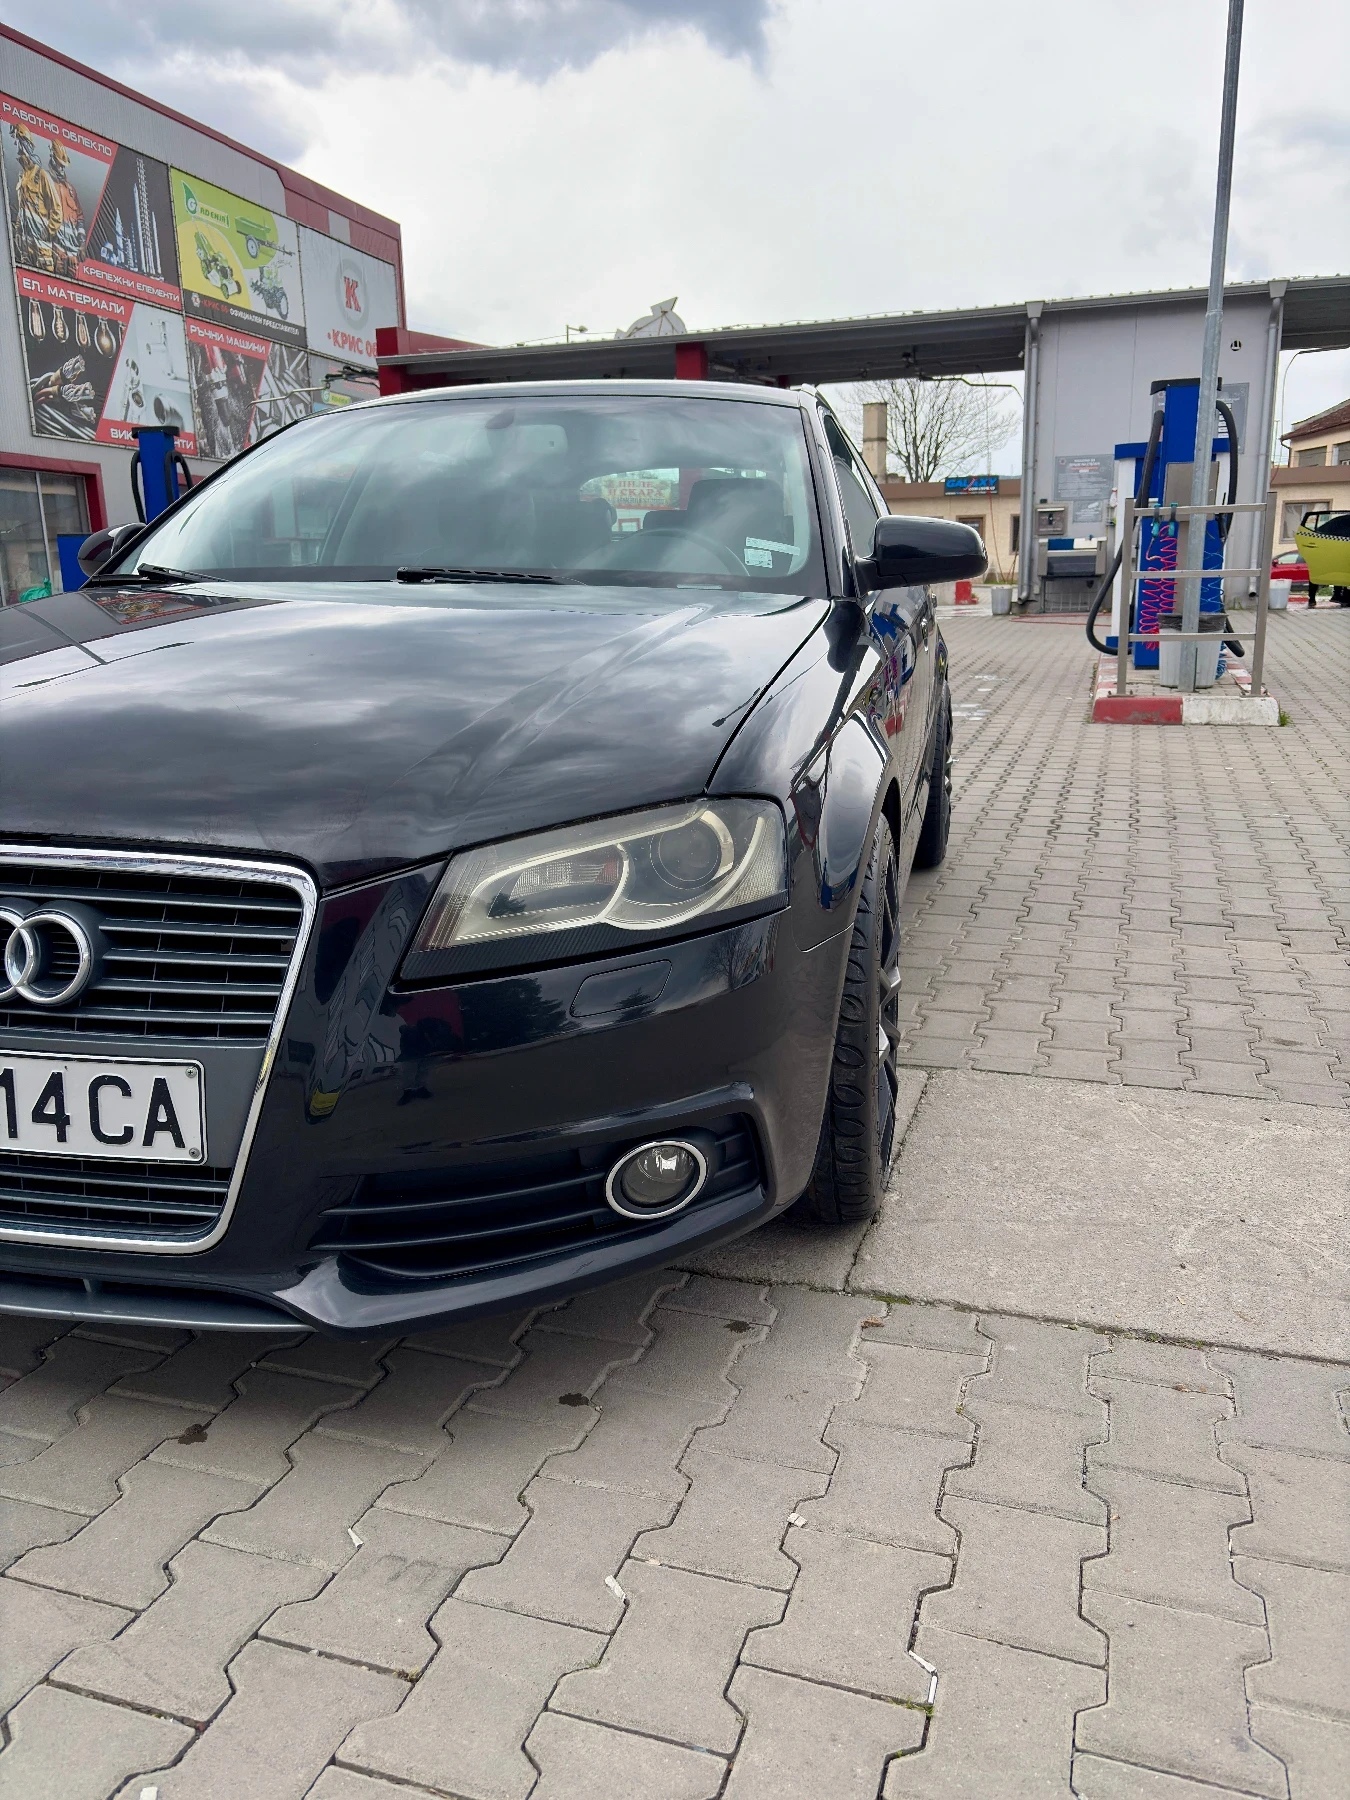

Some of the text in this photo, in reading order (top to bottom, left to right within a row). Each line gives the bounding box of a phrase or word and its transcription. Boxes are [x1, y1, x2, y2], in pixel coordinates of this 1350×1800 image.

[2, 102, 113, 157] РАБОТНО ОБЛЕКЛО
[22, 277, 125, 316] ЕЛ. МАТЕРИАЛИ
[83, 265, 180, 303] КРЕПЕЖНИ ЕЛЕМЕНТИ
[189, 324, 266, 355] РЪЧНИ МАШИНИ
[109, 427, 135, 442] ВИК
[946, 476, 998, 489] GALAXY
